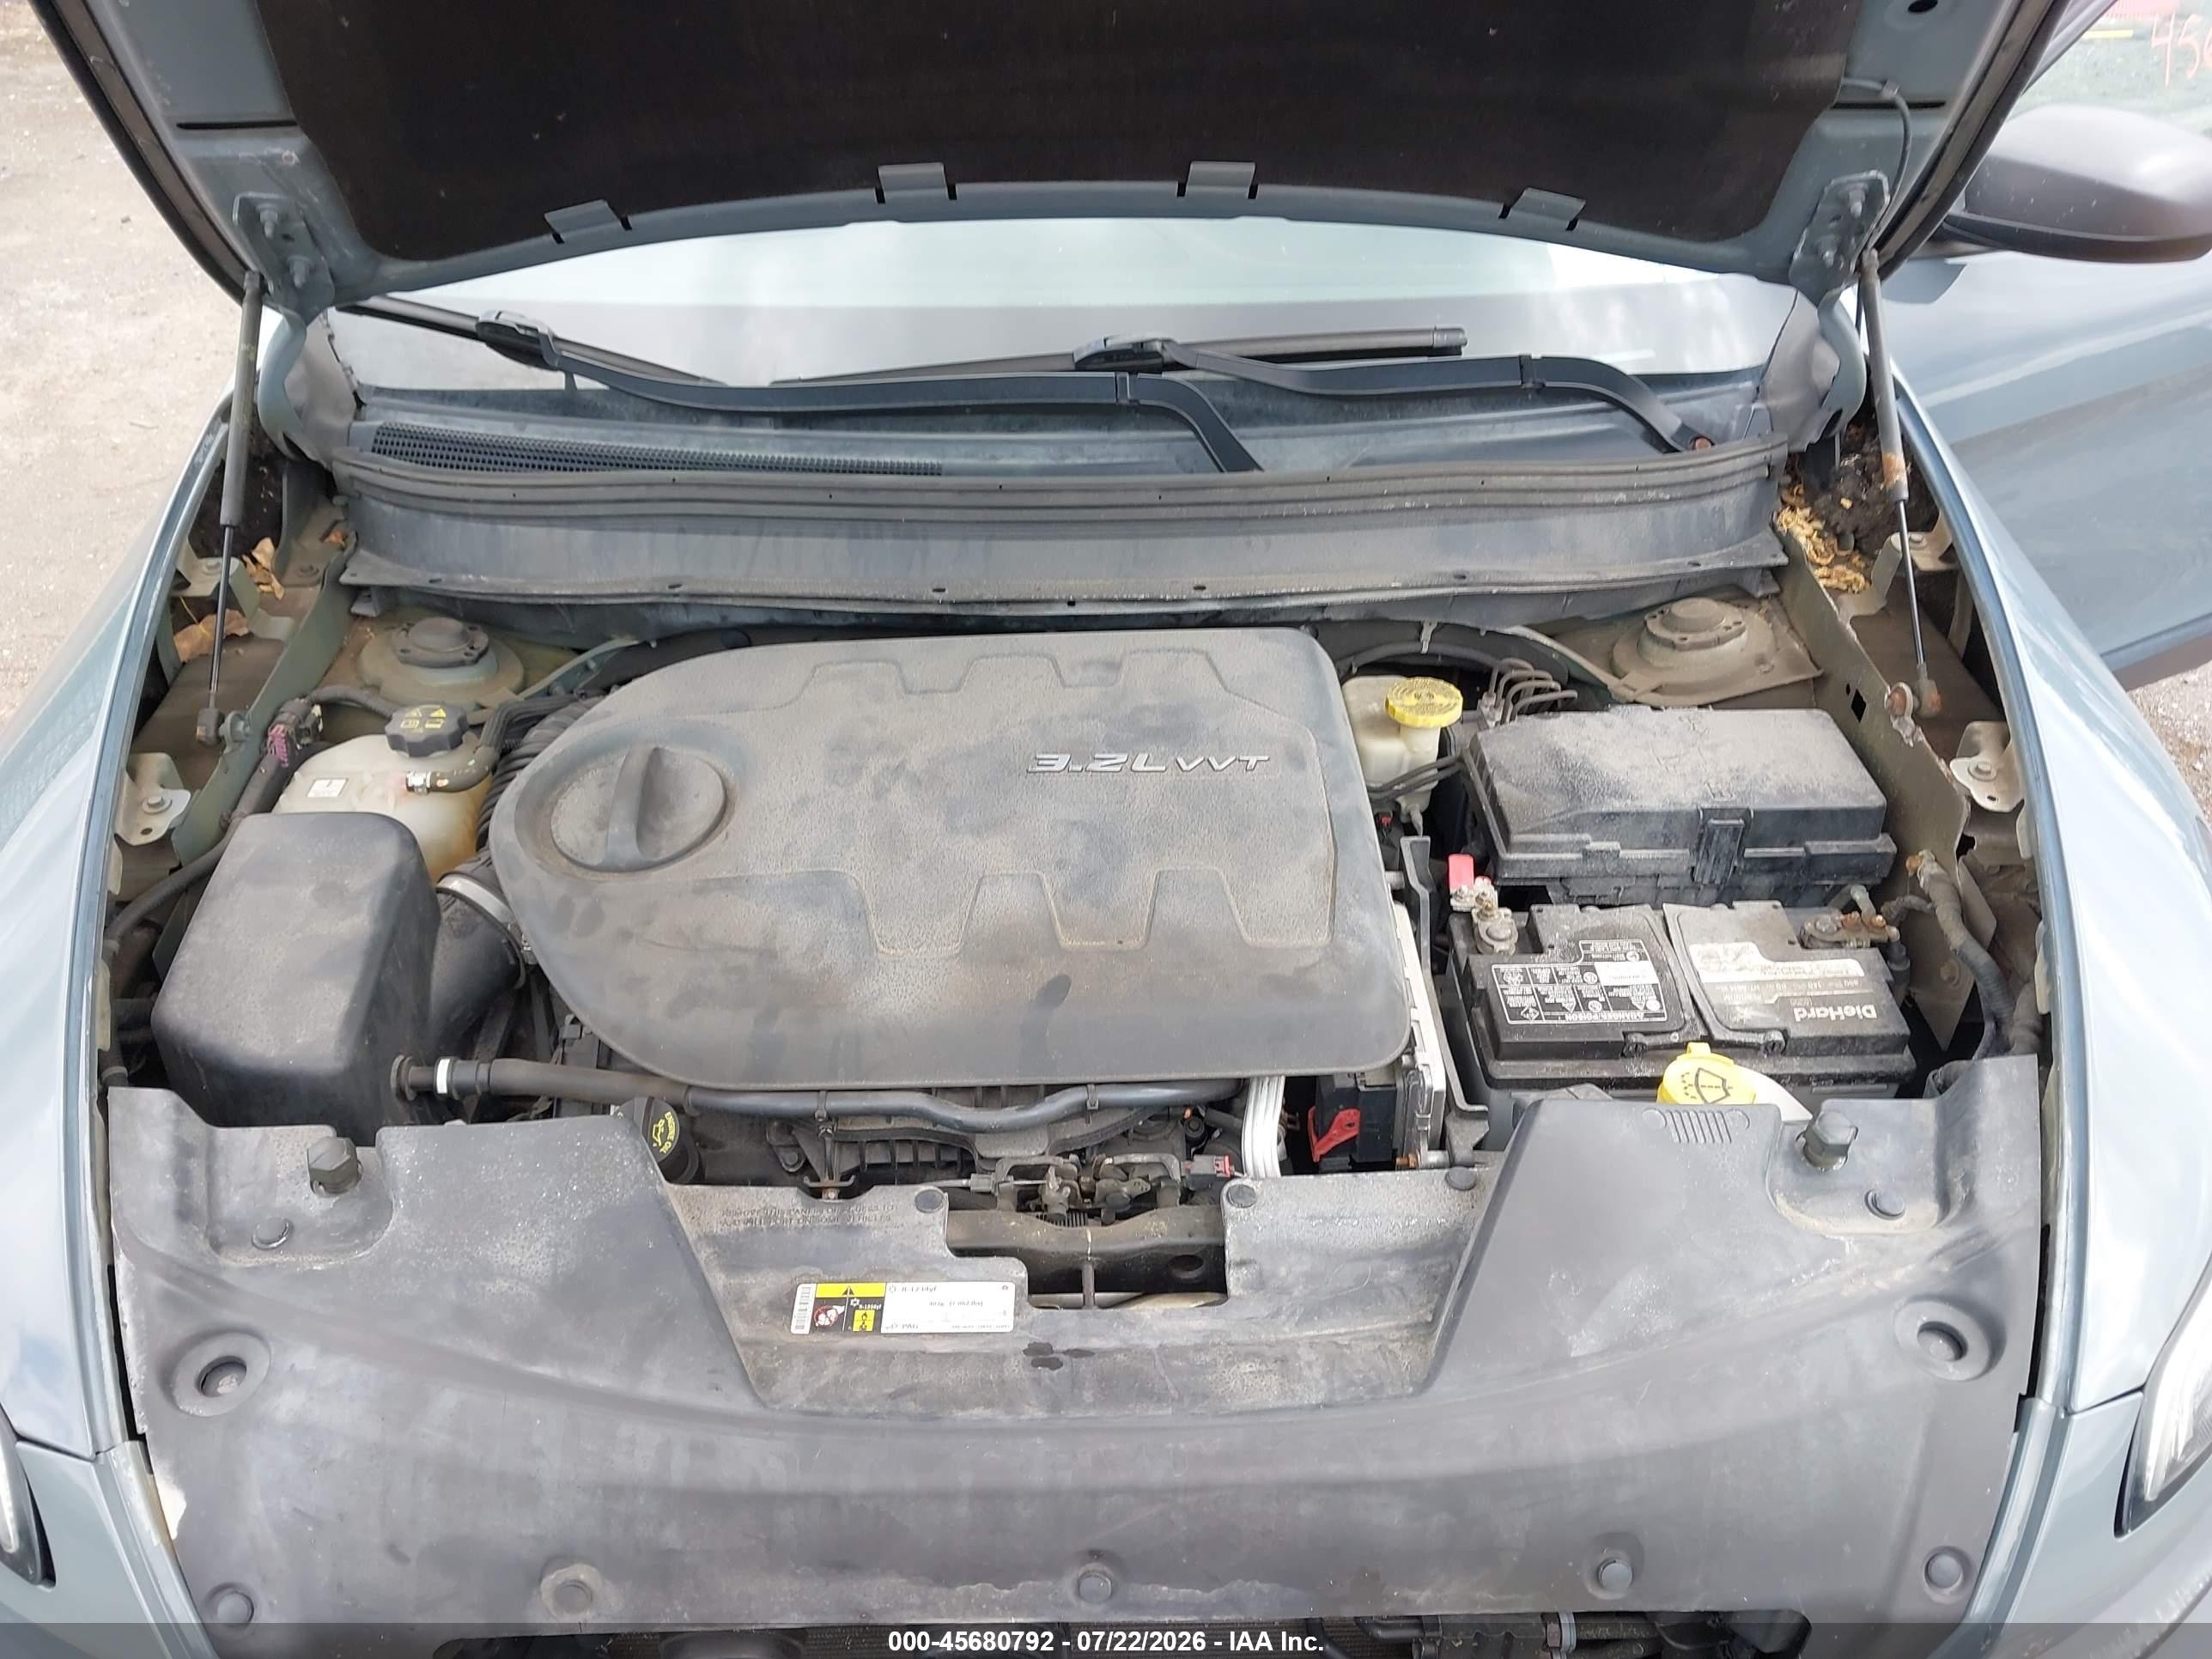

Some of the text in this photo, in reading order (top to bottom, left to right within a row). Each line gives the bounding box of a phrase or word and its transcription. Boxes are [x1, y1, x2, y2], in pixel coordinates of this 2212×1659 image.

[1027, 753, 1270, 773] 3.2L VVT
[1793, 1004, 1879, 1022] DieHard
